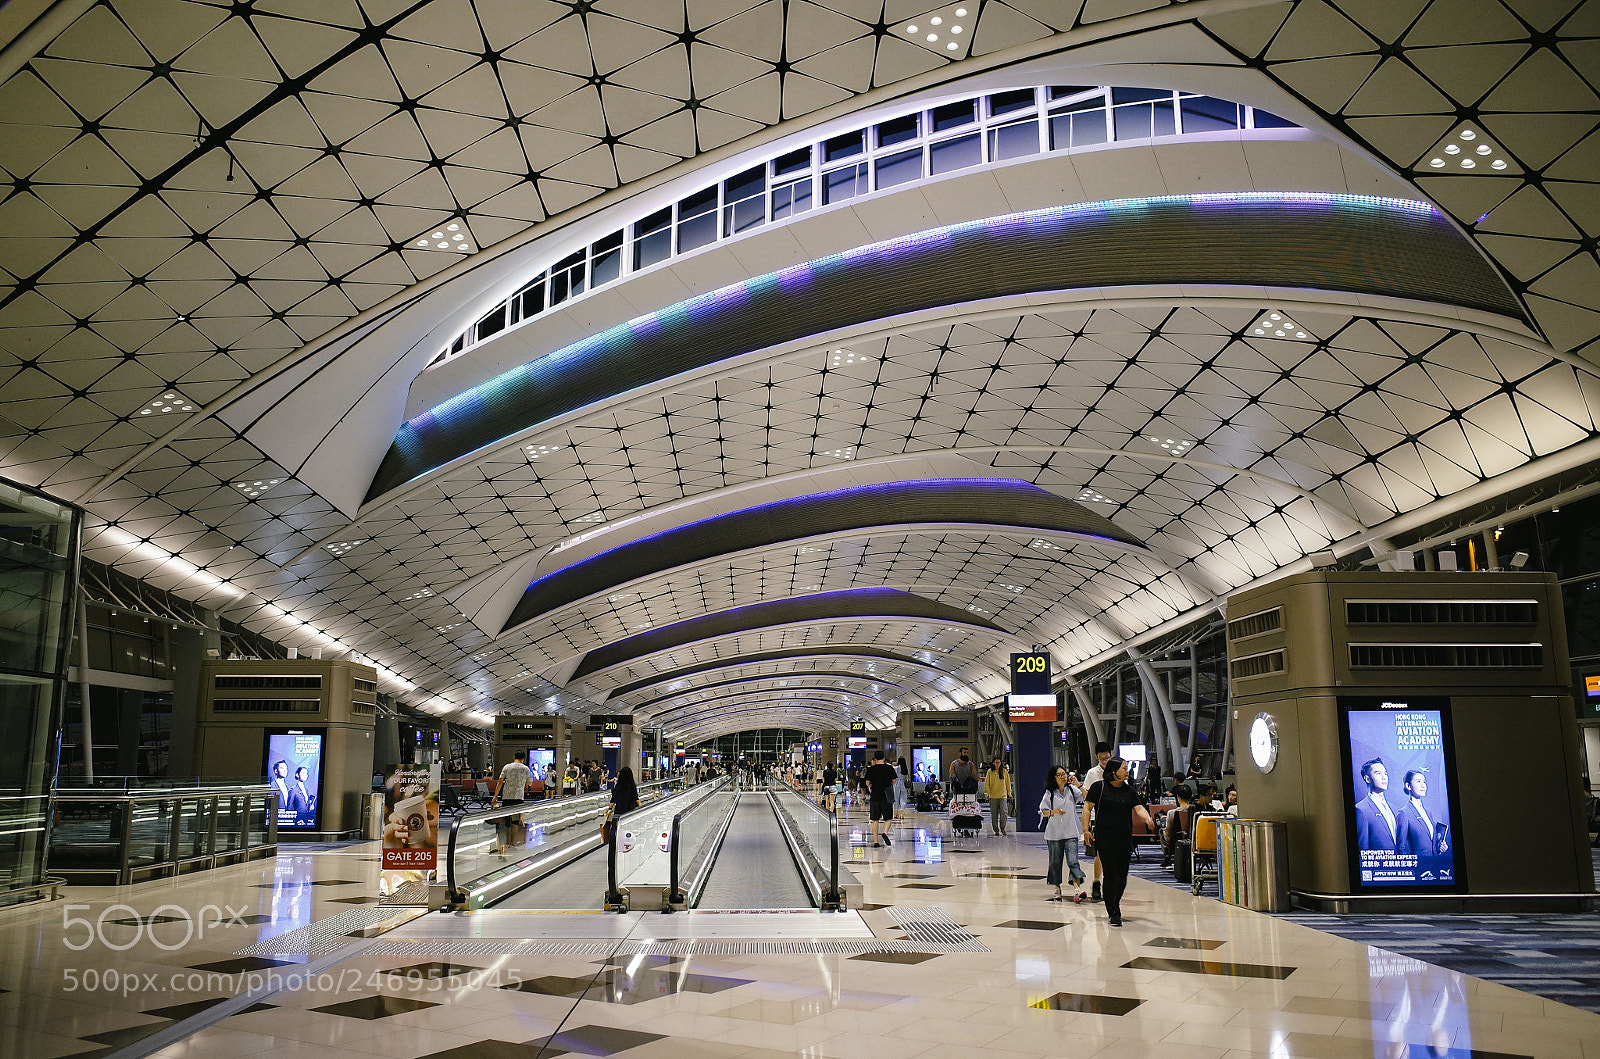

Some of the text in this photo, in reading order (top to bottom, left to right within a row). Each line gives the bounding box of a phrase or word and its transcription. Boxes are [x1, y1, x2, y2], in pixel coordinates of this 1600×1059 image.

[1016, 656, 1046, 673] 209
[605, 722, 617, 730] 210
[852, 722, 864, 730] 207
[1397, 726, 1439, 735] AVIATION
[1398, 736, 1440, 744] ACADEMY
[399, 784, 425, 797] coffee
[386, 851, 432, 861] GATE 205
